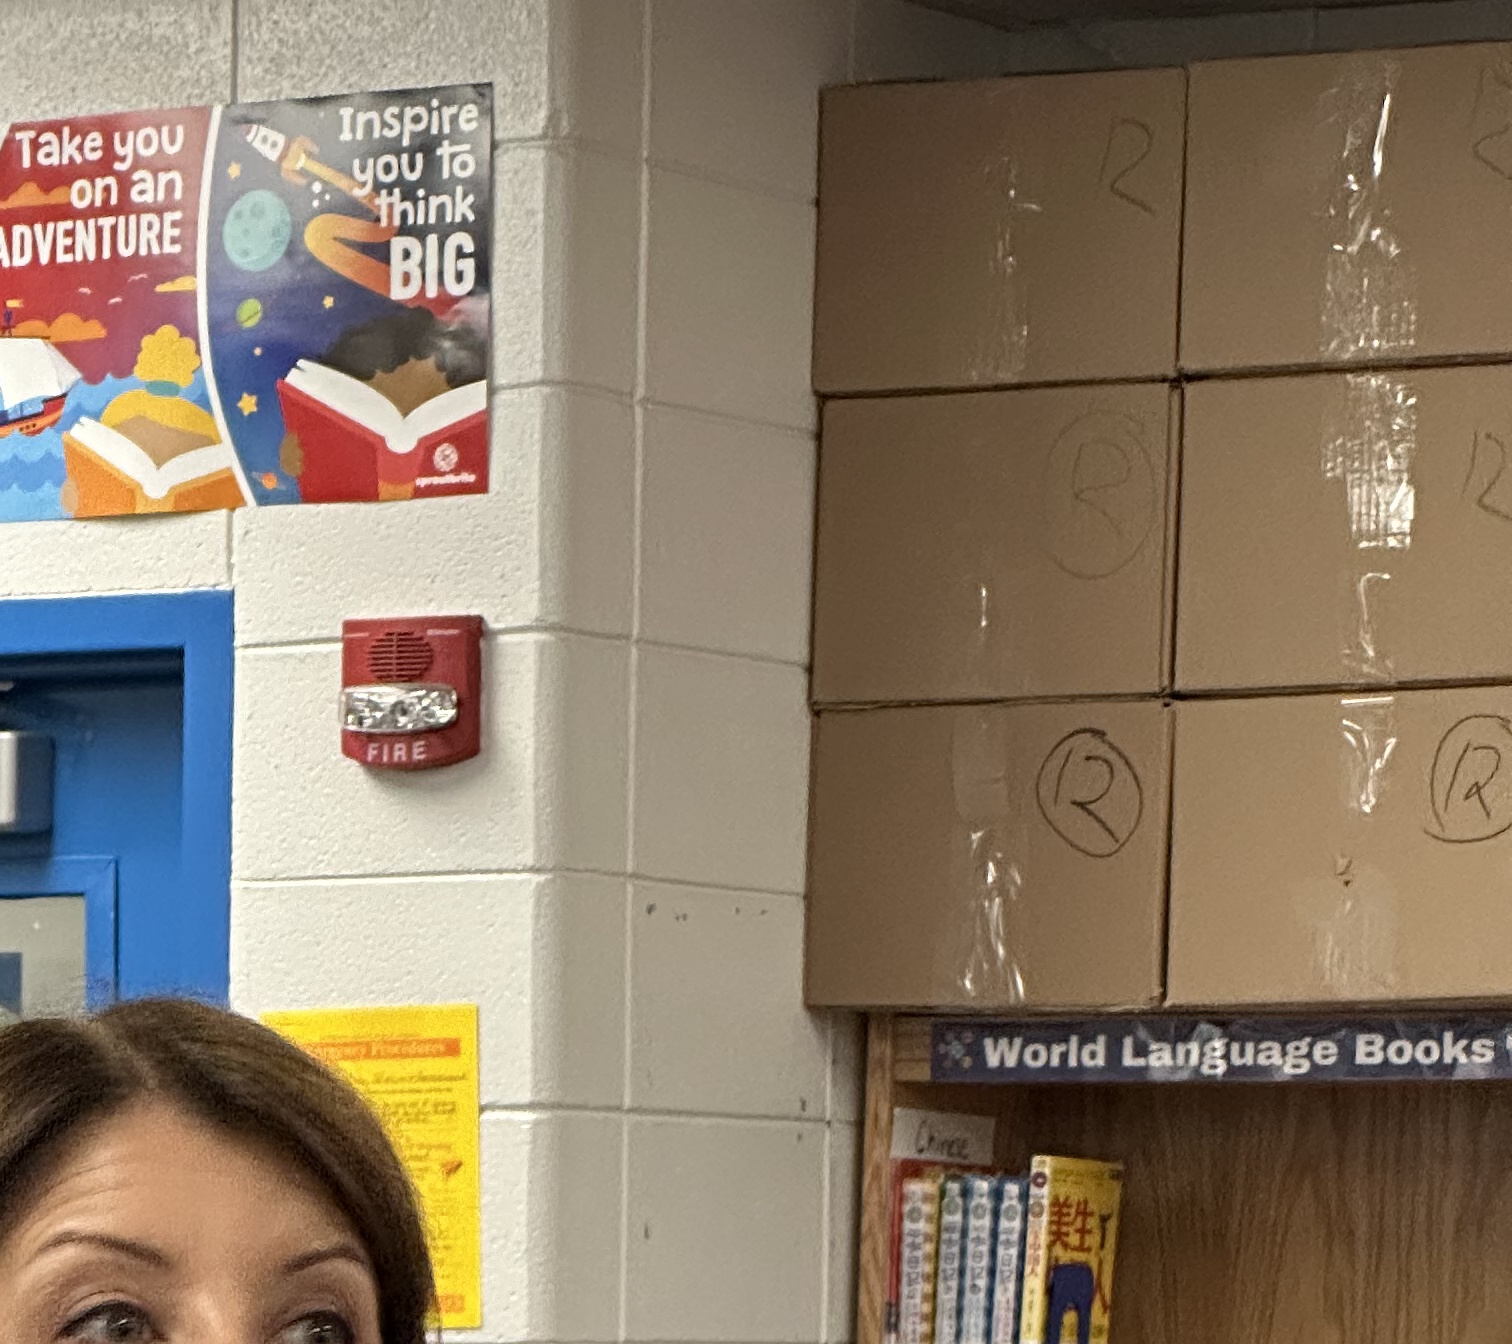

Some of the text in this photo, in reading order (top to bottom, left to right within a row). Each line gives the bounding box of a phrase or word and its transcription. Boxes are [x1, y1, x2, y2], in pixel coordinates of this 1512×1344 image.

[339, 99, 479, 148] Inspire
[15, 123, 185, 171] Take you
[69, 169, 183, 209] on an
[352, 143, 477, 198] you to
[375, 187, 476, 229] think
[389, 230, 476, 301] BIG
[365, 740, 428, 763] FIRE
[983, 1030, 1496, 1075] World Language Books
